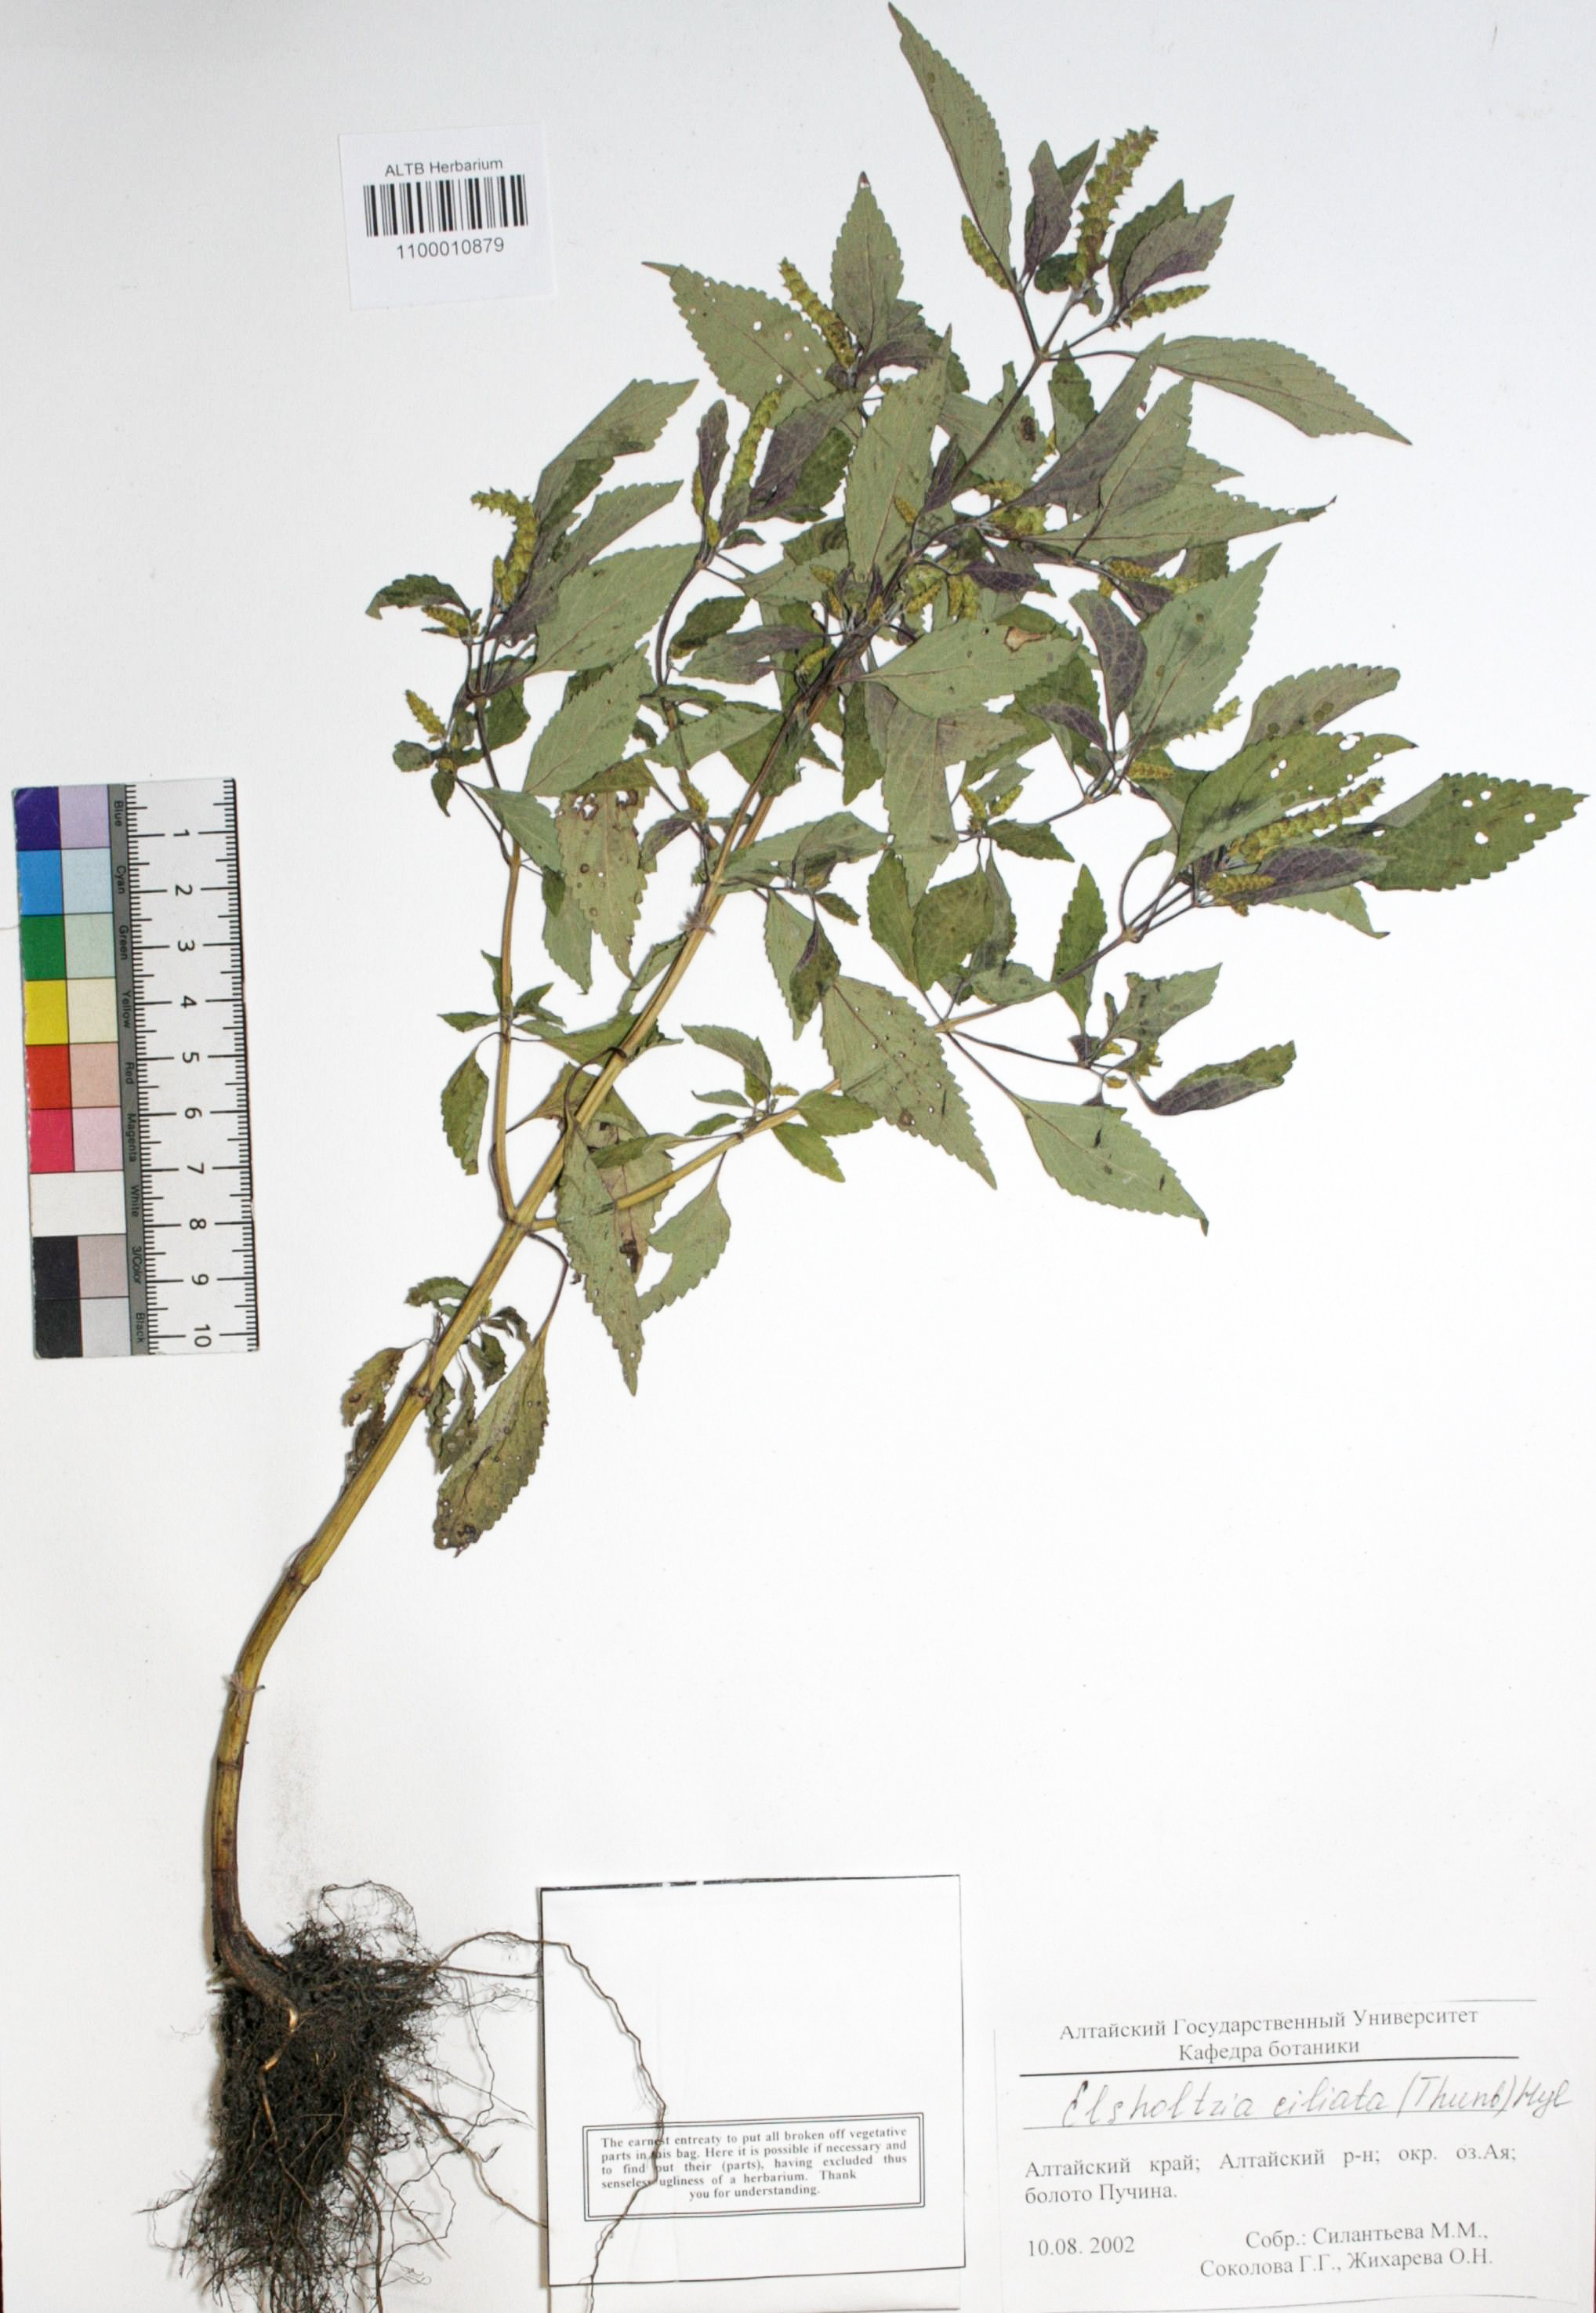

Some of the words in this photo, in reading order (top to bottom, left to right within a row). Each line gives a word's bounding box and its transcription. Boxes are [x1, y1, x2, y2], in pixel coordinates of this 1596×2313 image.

[385, 162, 424, 177] ALTB
[430, 158, 502, 174] Herbarium
[397, 237, 504, 259] 1100010879
[114, 801, 124, 827] Blue
[116, 865, 126, 895] Cyan
[175, 884, 193, 896] 2
[119, 925, 129, 960] Green
[178, 940, 195, 952] 3
[122, 990, 131, 1029] Yellow
[180, 995, 198, 1008] 4
[182, 1051, 200, 1063] 5
[125, 1062, 135, 1084] Red
[184, 1107, 202, 1120] 6
[125, 1113, 136, 1162] Magenta
[187, 1162, 204, 1175] 7
[130, 1185, 140, 1218] White
[189, 1218, 207, 1230] 8
[132, 1246, 142, 1285] 3/Color
[191, 1273, 209, 1286] 9
[136, 1313, 145, 1343] Black
[194, 1324, 212, 1348] 10
[1060, 2020, 1166, 2040] Алтайский
[1174, 2012, 1346, 2038] Государственный
[1353, 2009, 1478, 2028] Университет
[1179, 2042, 1263, 2064] Кафедра
[1268, 2040, 1359, 2057] ботаники
[1274, 2076, 1389, 2118] ciliata
[600, 2137, 623, 2148] The
[675, 2136, 721, 2146] entreaty
[727, 2134, 737, 2144] to
[742, 2133, 760, 2145] put
[765, 2131, 779, 2141] all
[785, 2130, 824, 2141] broken
[829, 2129, 846, 2139] off
[850, 2126, 907, 2140] vegetative
[601, 2151, 631, 2164] parts
[637, 2150, 646, 2159] in
[676, 2148, 700, 2159] bag.
[706, 2148, 733, 2158] Here
[738, 2147, 745, 2156] it
[750, 2146, 760, 2155] is
[764, 2143, 809, 2157] possible
[814, 2143, 822, 2153] if
[826, 2143, 881, 2154] necessary
[886, 2141, 906, 2150] and
[1025, 2158, 1130, 2177] Алтайский
[1150, 2155, 1200, 2176] край;
[1220, 2149, 1325, 2170] Алтайский
[1344, 2149, 1380, 2168] р-н;
[1398, 2148, 1437, 2165] окр.
[1456, 2144, 1516, 2162] оз.Ая;
[601, 2166, 612, 2174] to
[623, 2163, 645, 2174] find
[684, 2162, 712, 2172] their
[722, 2159, 764, 2173] (parts),
[774, 2158, 812, 2170] having
[823, 2155, 872, 2166] excluded
[883, 2154, 907, 2164] thus
[659, 2176, 704, 2188] ugliness
[712, 2175, 723, 2185] of
[743, 2172, 808, 2184] herbarium.
[819, 2170, 857, 2180] Thank
[689, 2190, 709, 2201] you
[714, 2188, 731, 2199] for
[735, 2184, 820, 2197] understanding.
[1025, 2188, 1093, 2204] болото
[1098, 2184, 1177, 2204] Пучина.
[1028, 2238, 1083, 2257] 10.08.
[1090, 2236, 1135, 2253] 2002
[1246, 2230, 1305, 2251] Собр.:
[1313, 2226, 1424, 2245] Силантьева
[1431, 2221, 1489, 2239] М.М.,
[1200, 2259, 1293, 2277] Соколова
[1299, 2253, 1341, 2273] Г.Г.,
[1348, 2251, 1443, 2271] Жихарева
[1449, 2247, 1493, 2264] О.Н.
